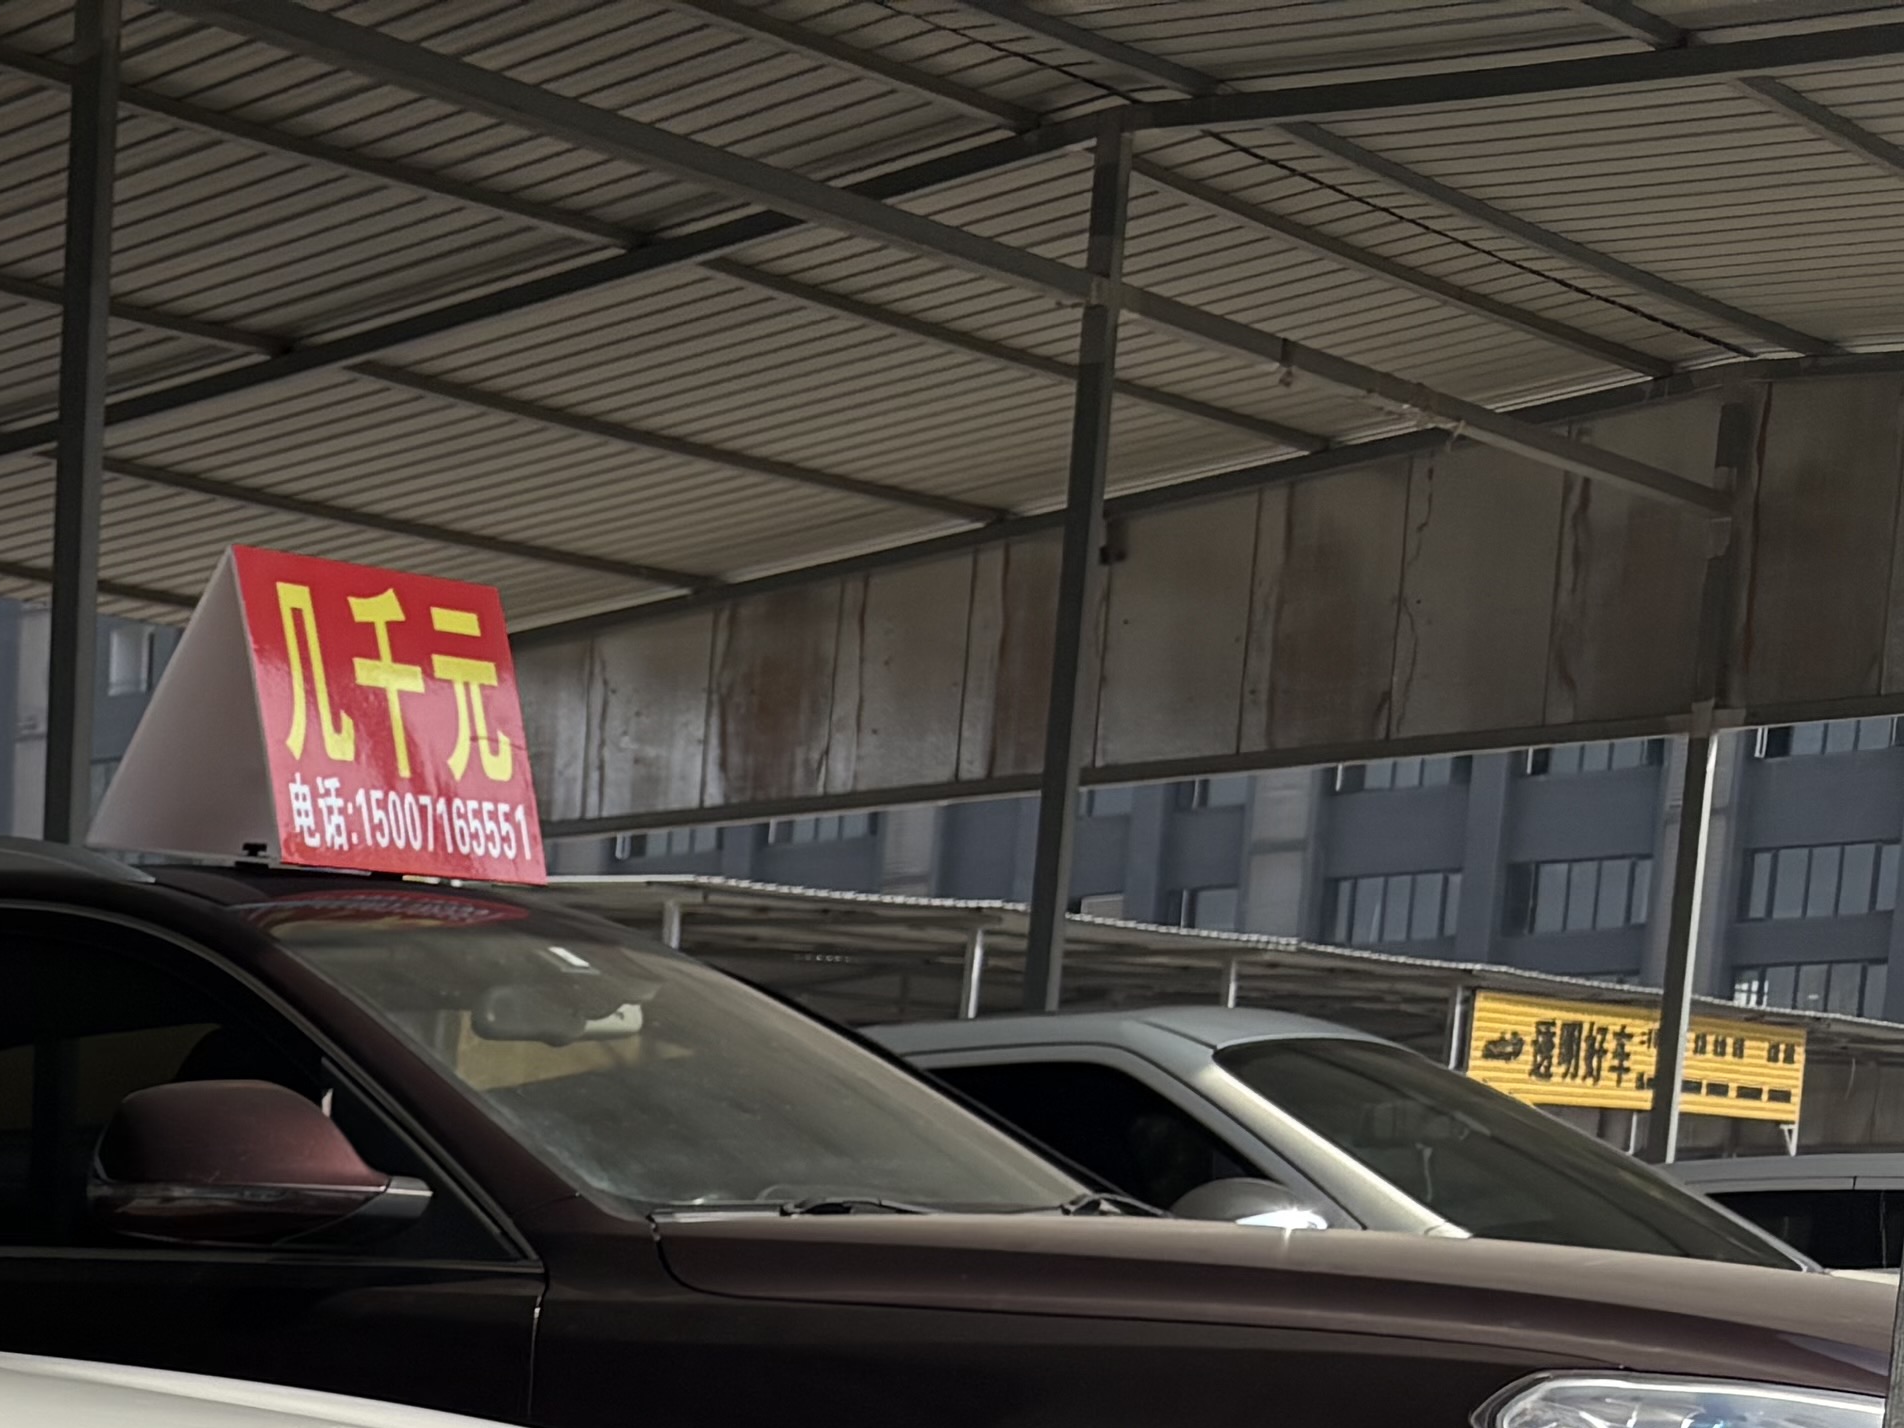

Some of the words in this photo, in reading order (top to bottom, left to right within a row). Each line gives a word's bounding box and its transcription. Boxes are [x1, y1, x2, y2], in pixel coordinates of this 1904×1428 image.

[276, 581, 513, 782] 几千元
[289, 772, 532, 861] 电话:15007165551
